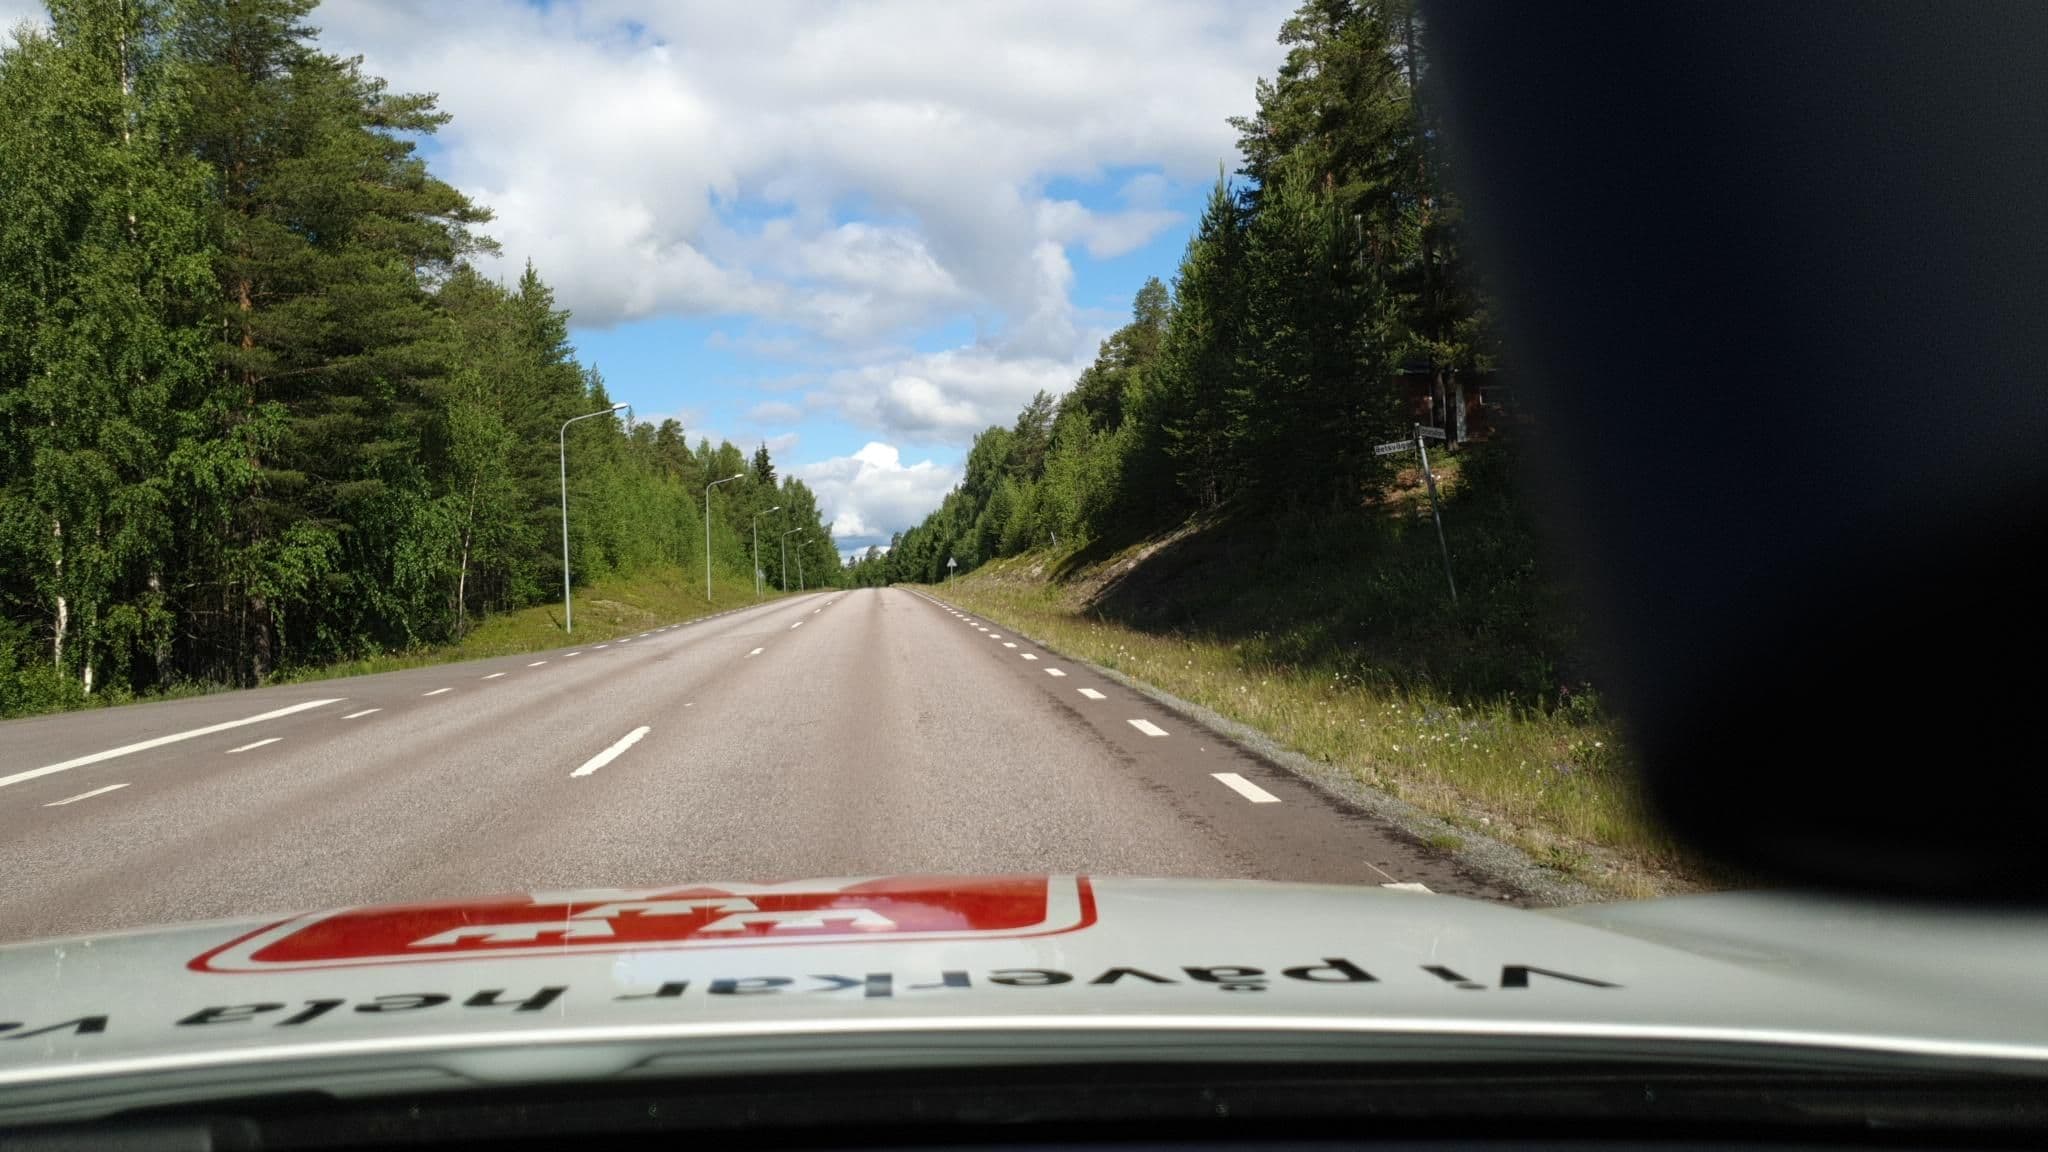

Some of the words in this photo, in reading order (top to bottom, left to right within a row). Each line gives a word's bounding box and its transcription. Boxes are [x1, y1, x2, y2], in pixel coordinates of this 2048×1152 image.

[614, 958, 1381, 1000] påverkar
[1420, 964, 1624, 989] Vi
[176, 985, 570, 1026] hela
